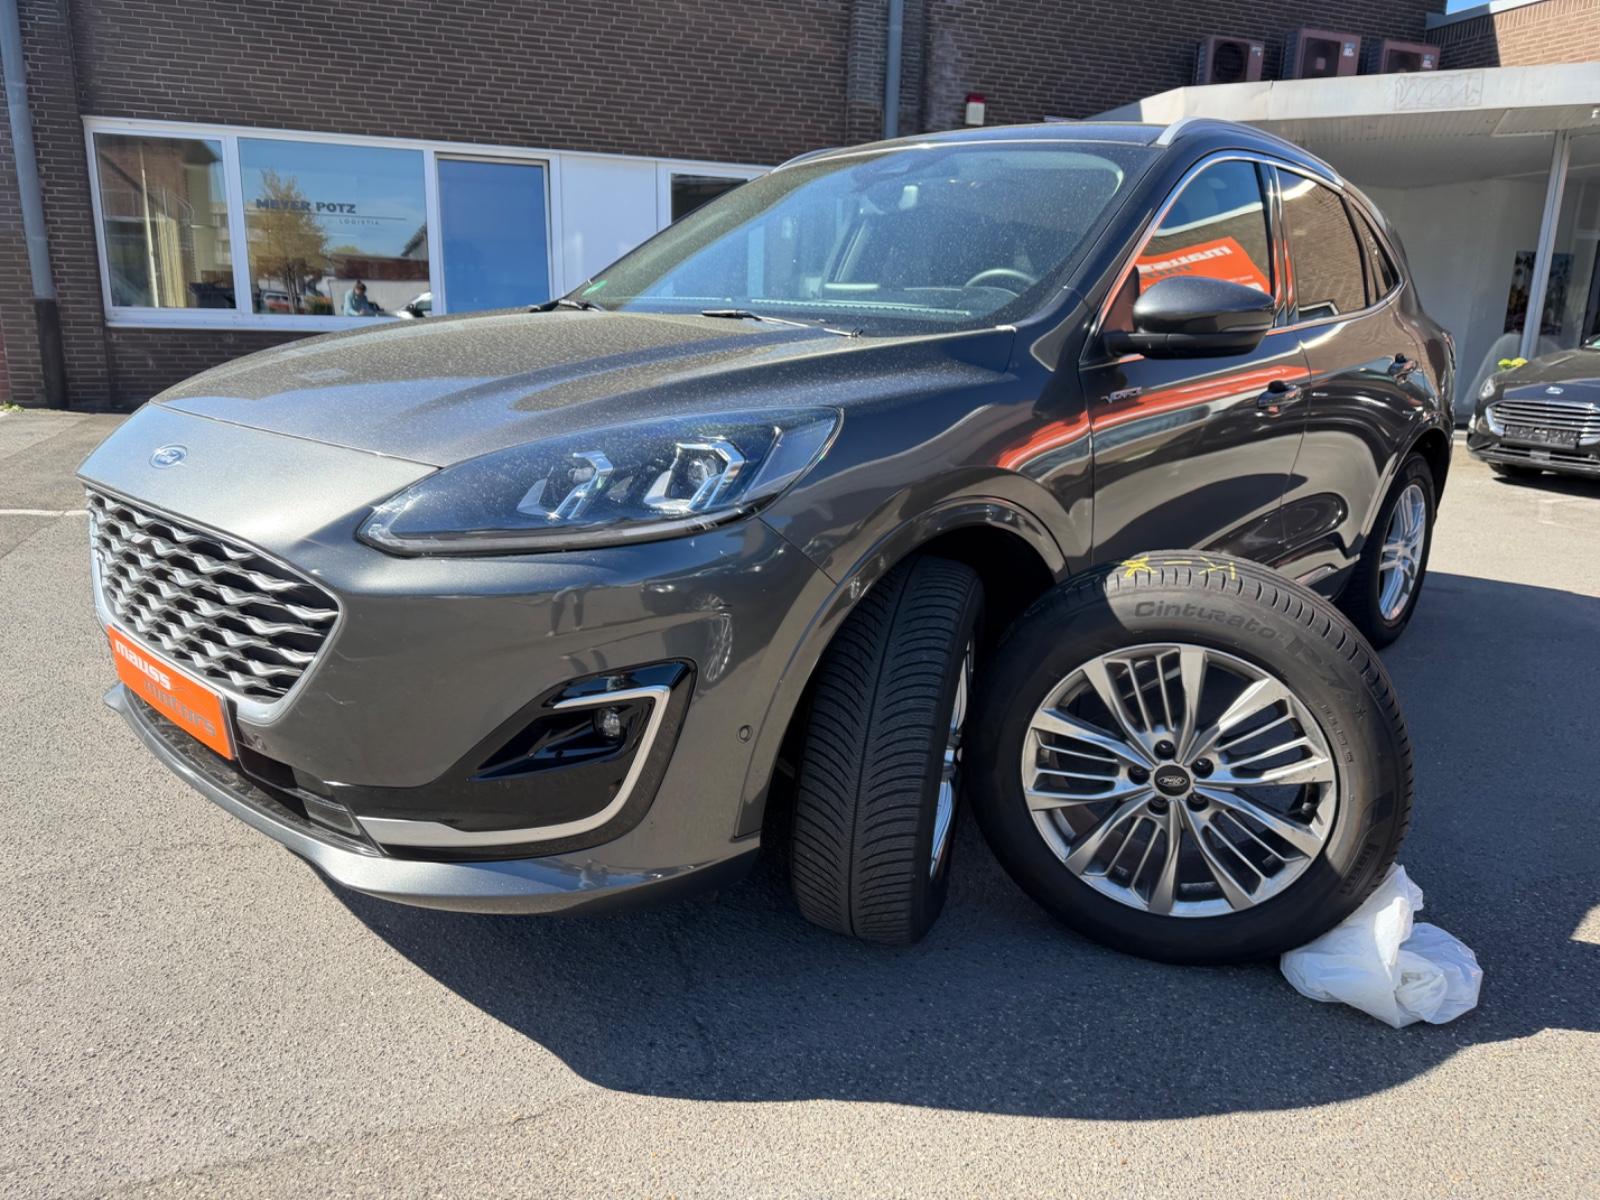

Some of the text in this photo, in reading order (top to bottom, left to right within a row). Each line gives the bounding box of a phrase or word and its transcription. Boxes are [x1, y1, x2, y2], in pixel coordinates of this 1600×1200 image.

[255, 198, 357, 214] MEYER POTZ
[1133, 600, 1277, 640] Cinturato
[115, 639, 172, 691] mauss
